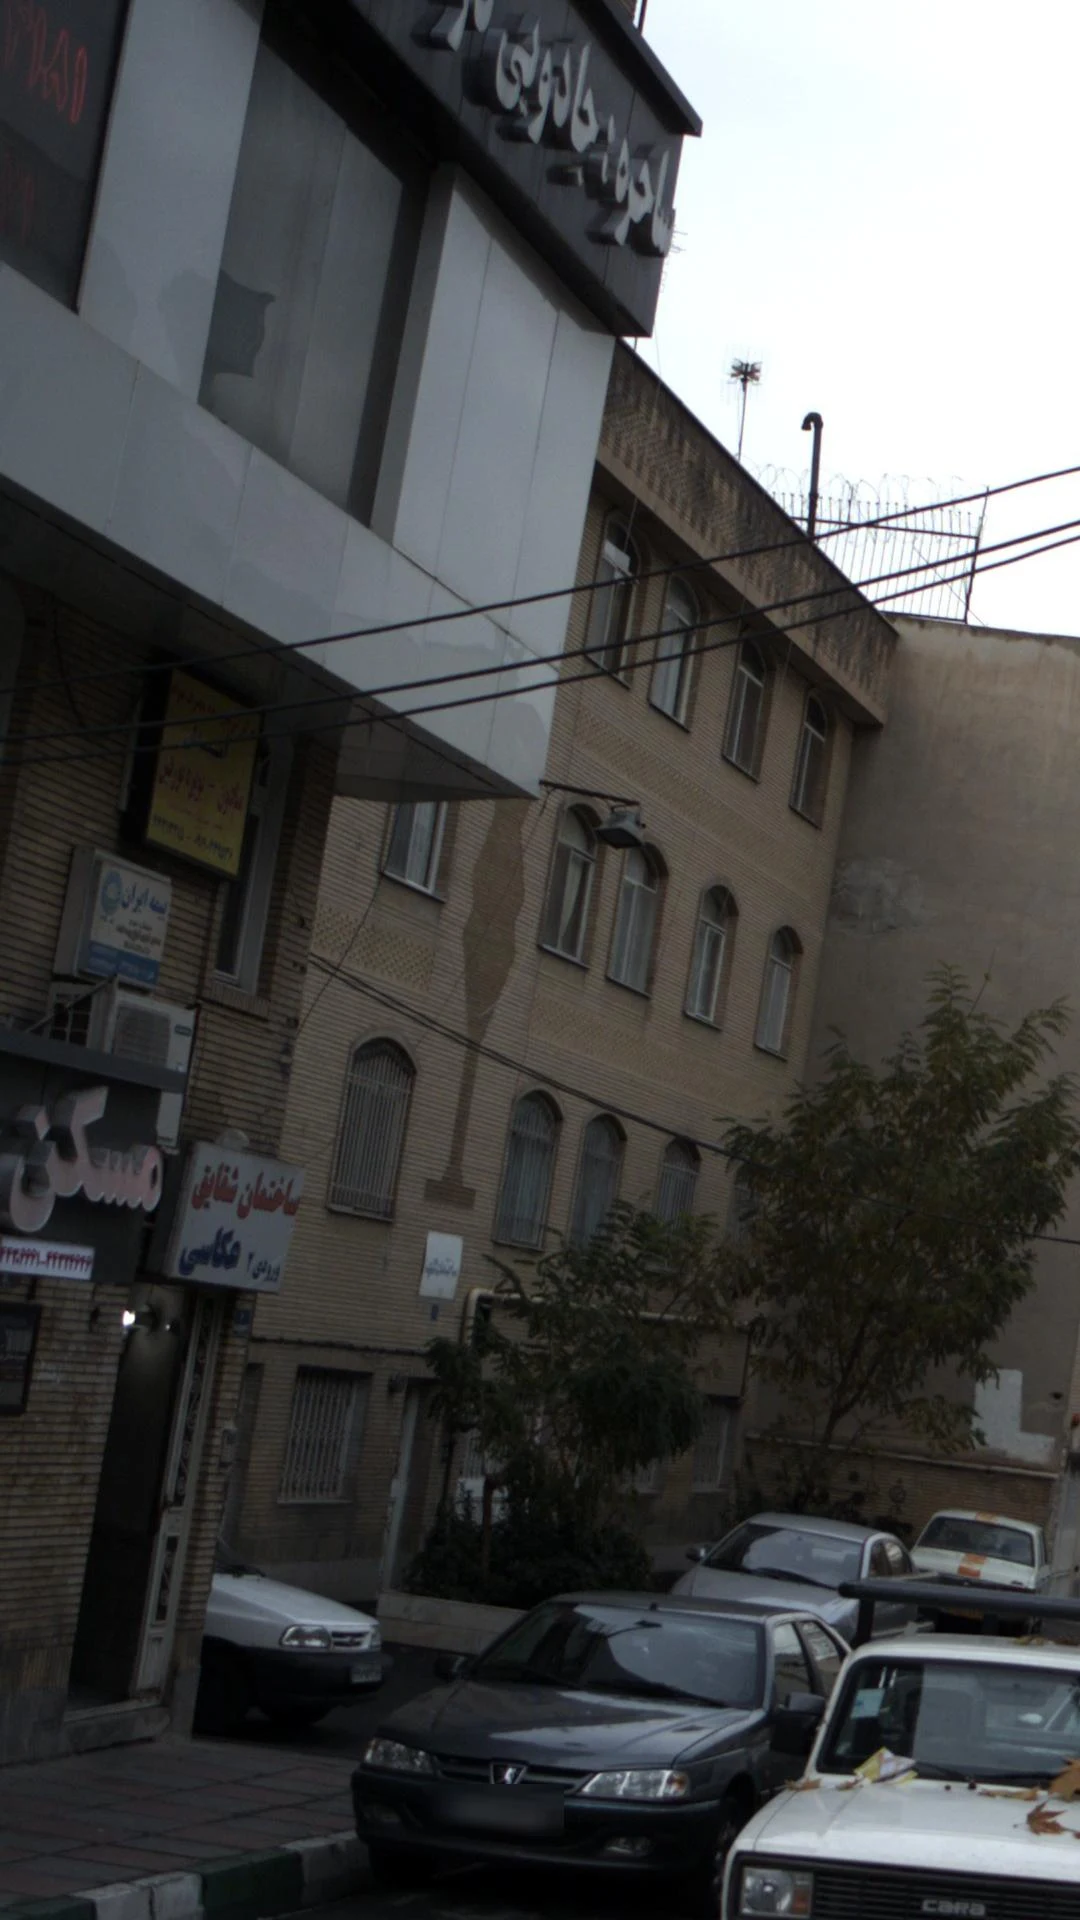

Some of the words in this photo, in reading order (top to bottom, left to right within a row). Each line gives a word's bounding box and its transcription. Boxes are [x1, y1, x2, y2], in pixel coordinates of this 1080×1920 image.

[122, 883, 149, 914] ایران
[10, 1085, 164, 1232] مسکن
[191, 1161, 239, 1210] شقایق
[236, 1172, 301, 1220] ساختمان
